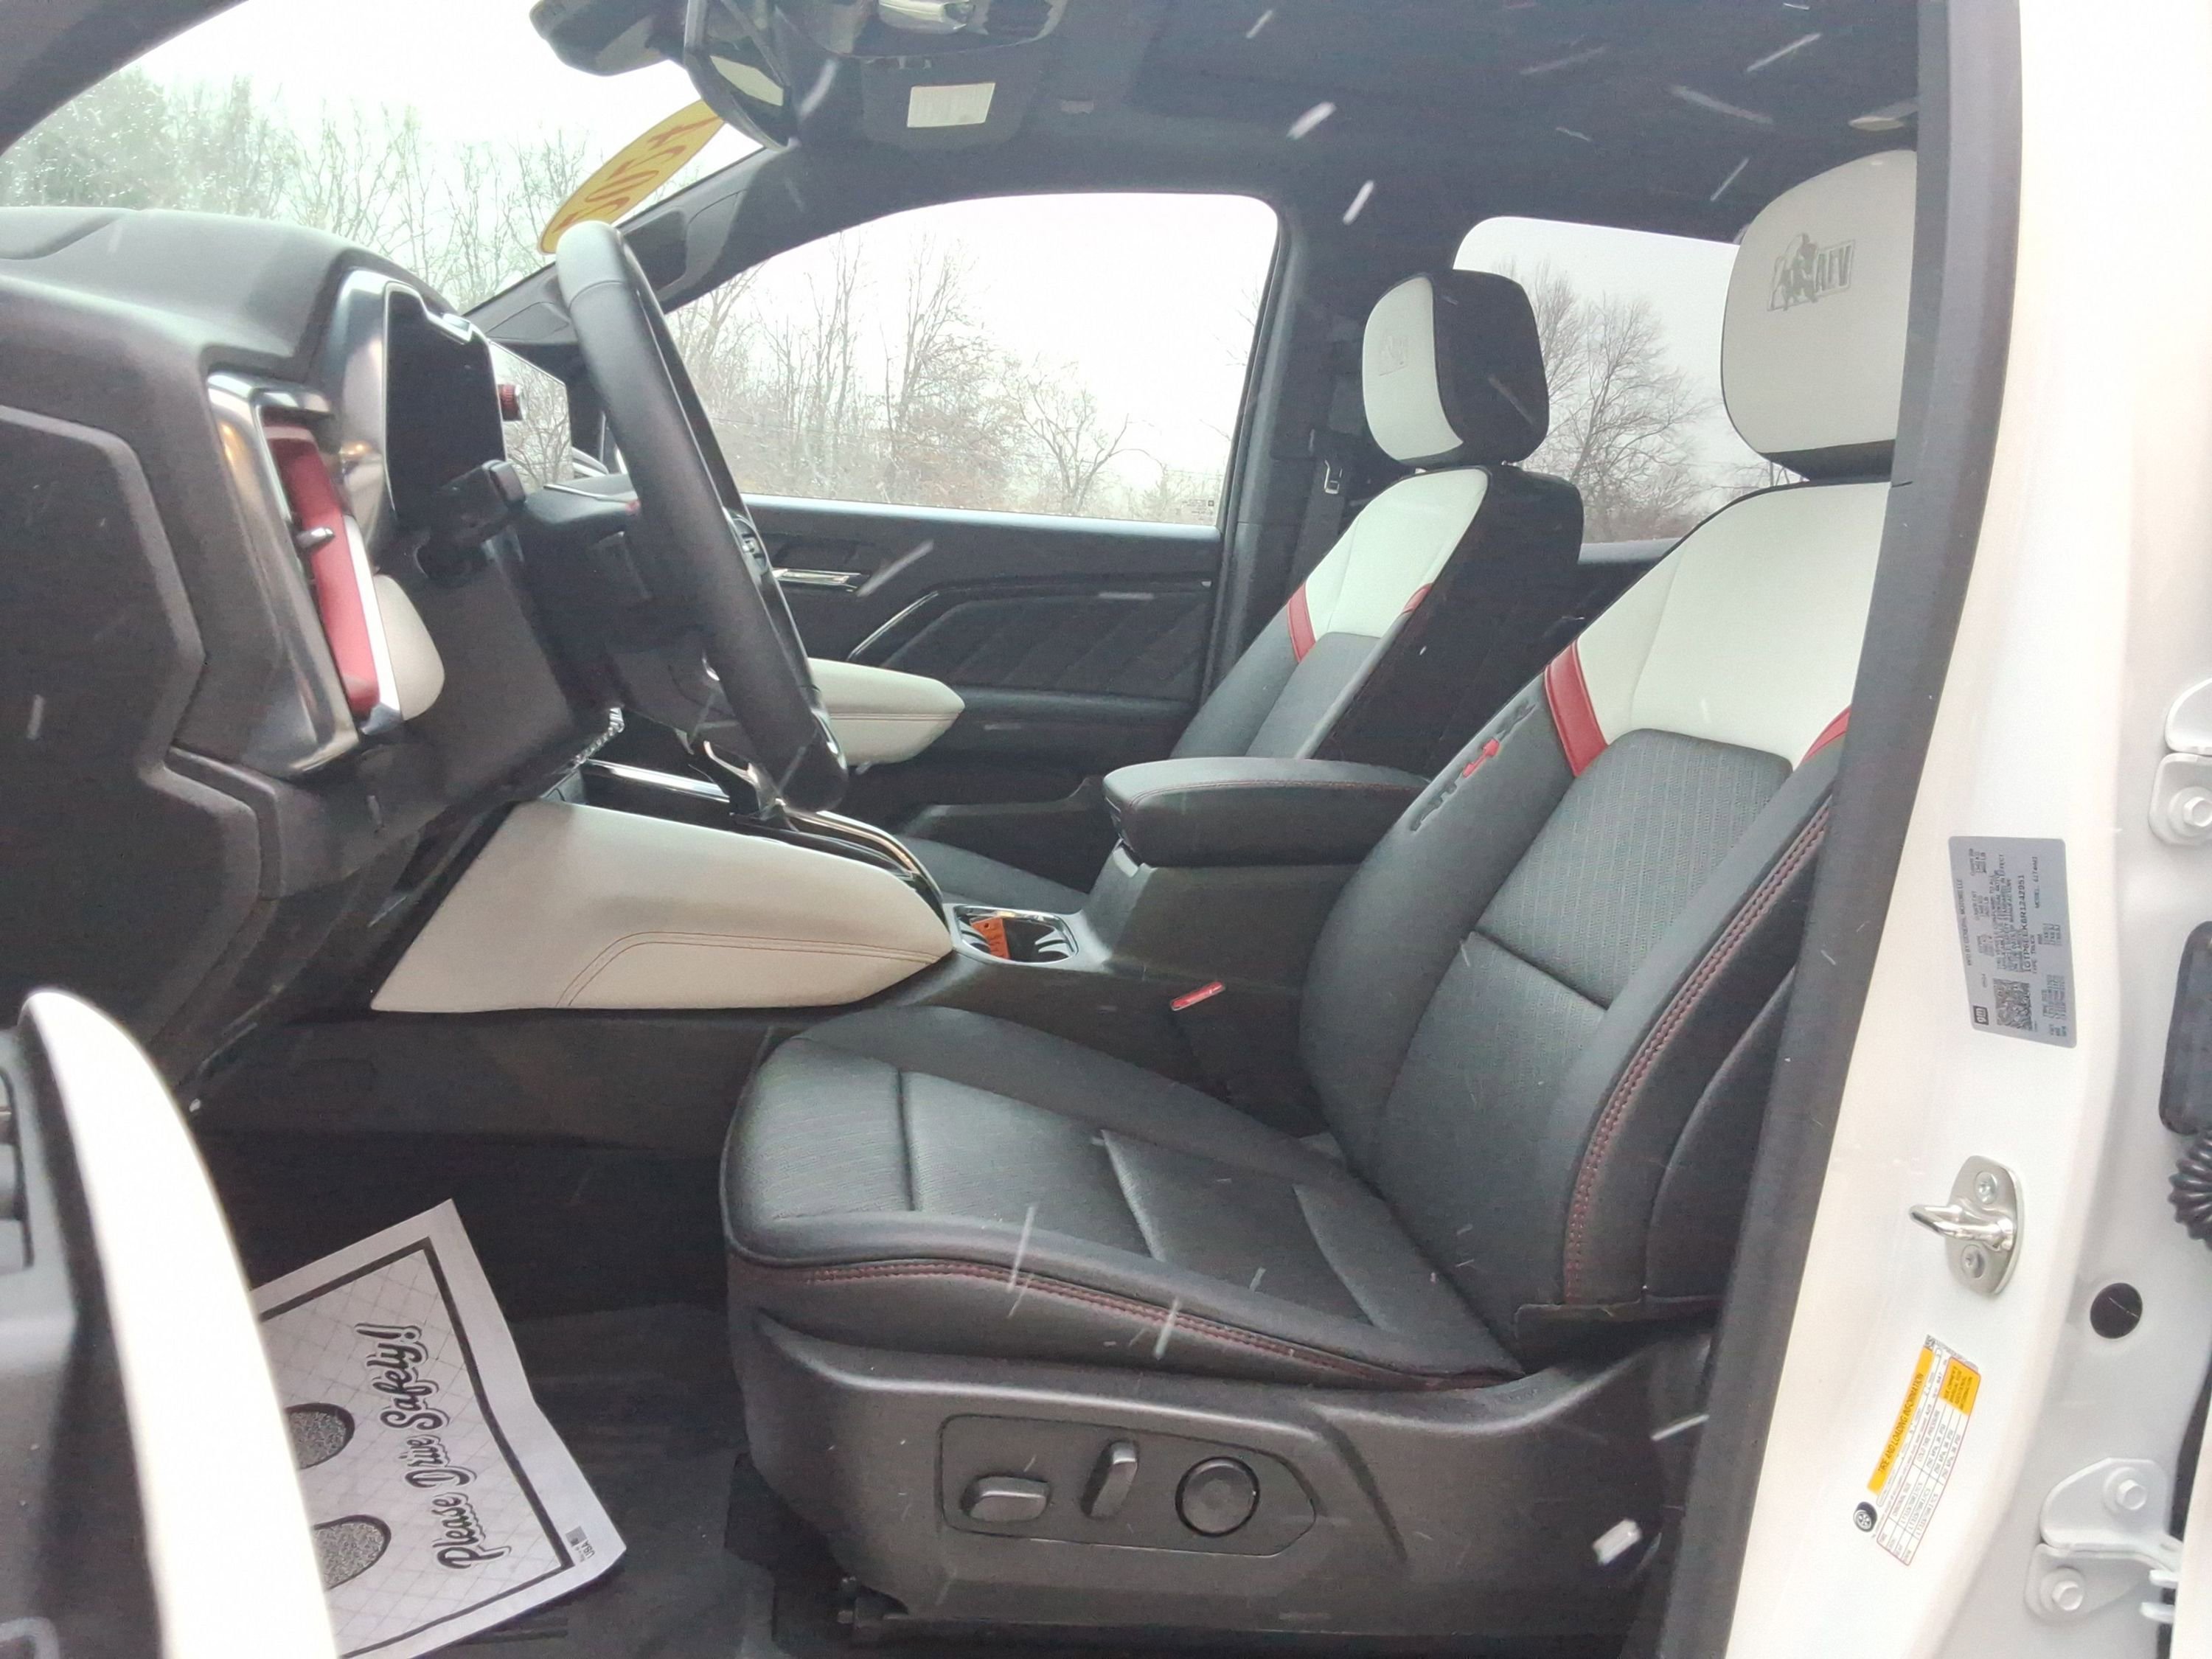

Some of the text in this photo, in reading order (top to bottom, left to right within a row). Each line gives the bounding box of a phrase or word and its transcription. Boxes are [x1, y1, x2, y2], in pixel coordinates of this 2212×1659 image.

[355, 1323, 512, 1568] Please Drive Safely!
[1884, 1444, 1896, 1459] AND
[1890, 1414, 1908, 1446] LOADING
[1902, 1371, 1924, 1416] INFORMATION
